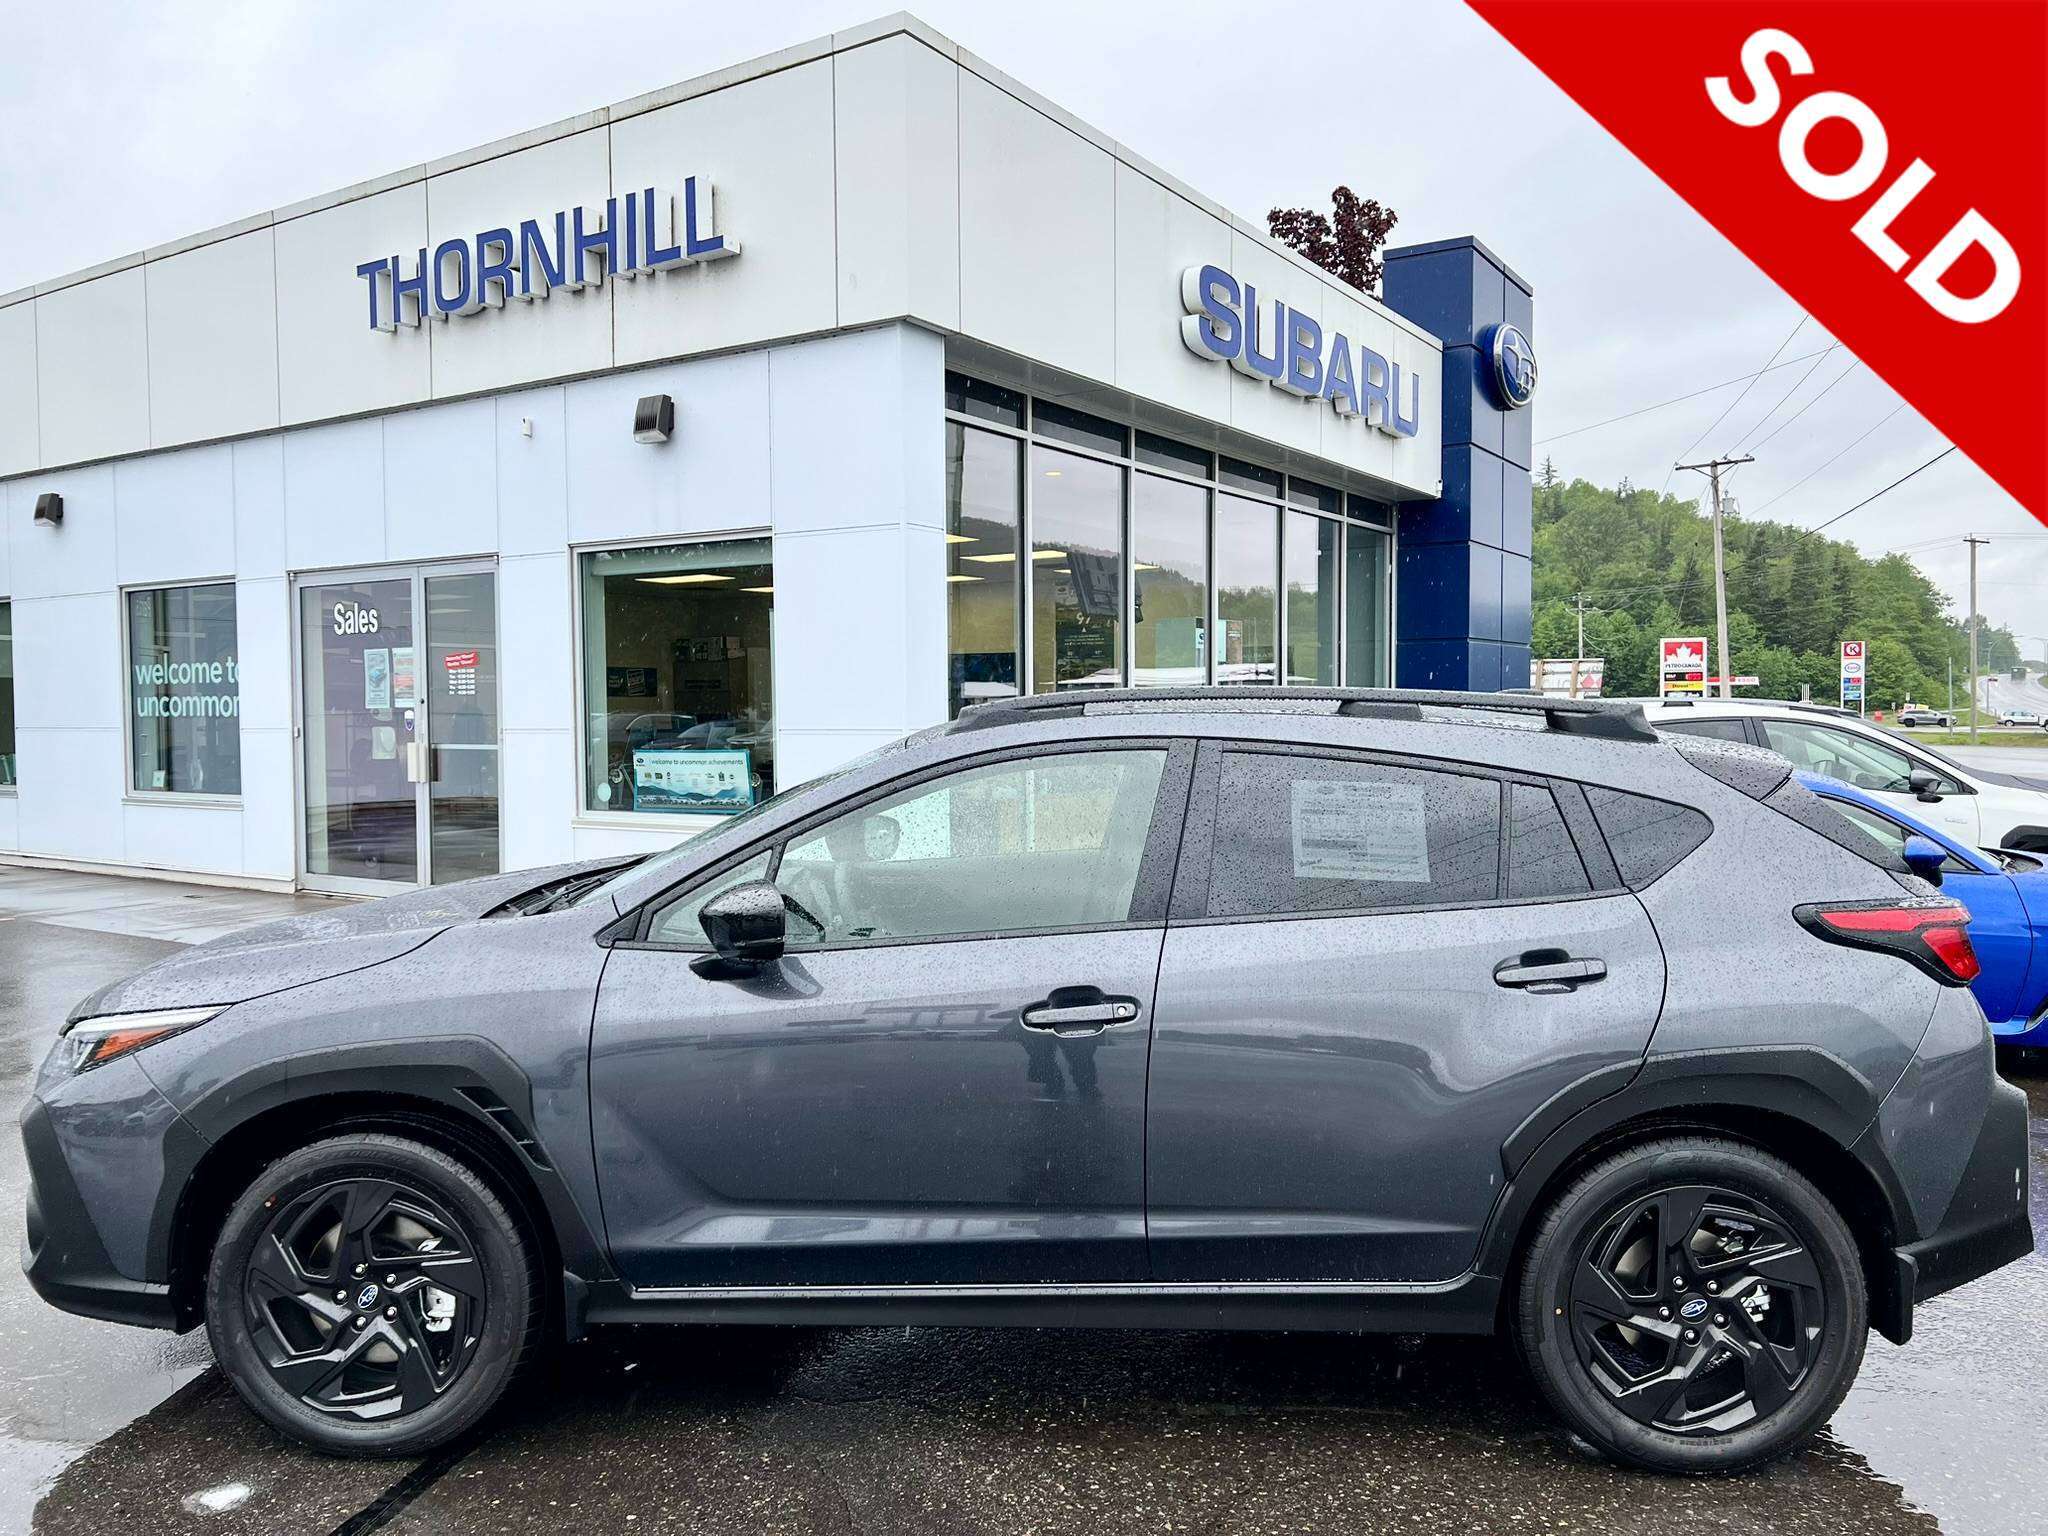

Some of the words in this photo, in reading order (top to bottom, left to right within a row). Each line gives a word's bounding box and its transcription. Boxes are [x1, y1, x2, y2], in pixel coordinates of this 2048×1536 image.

[356, 176, 740, 332] THORNHILL
[1183, 264, 1420, 438] SUBARU
[333, 602, 379, 636] Sales
[135, 653, 223, 685] welcome
